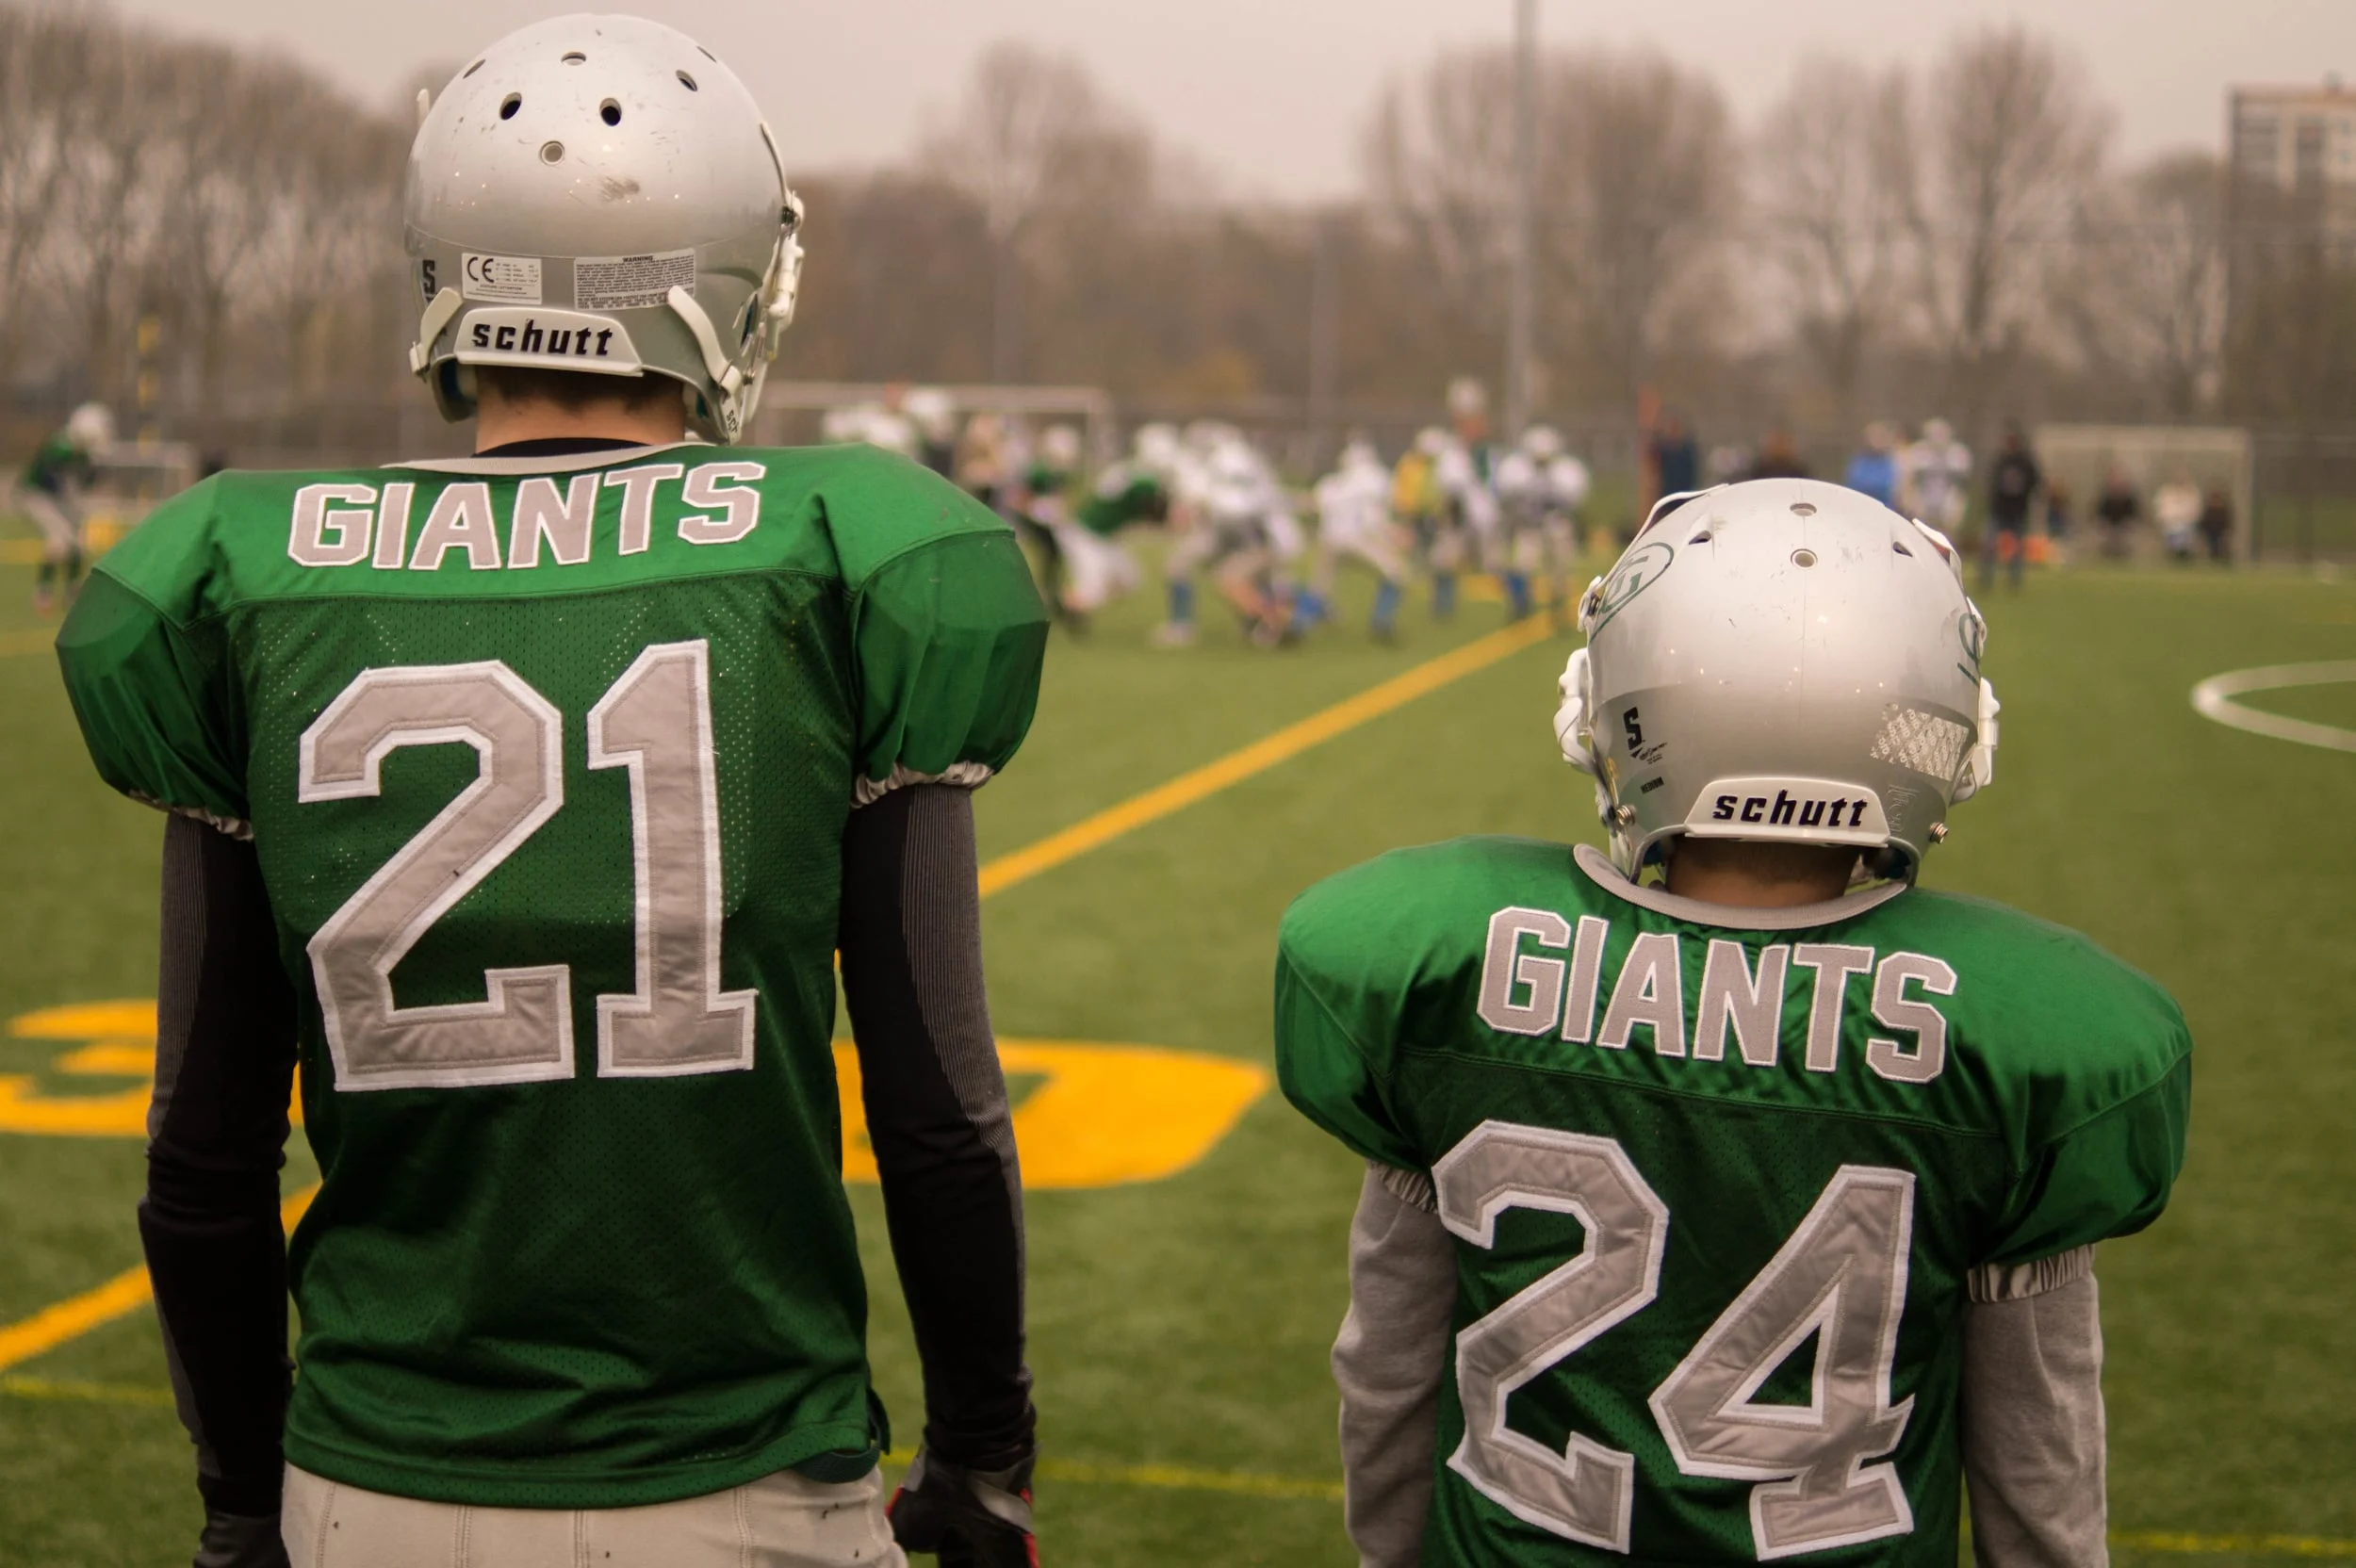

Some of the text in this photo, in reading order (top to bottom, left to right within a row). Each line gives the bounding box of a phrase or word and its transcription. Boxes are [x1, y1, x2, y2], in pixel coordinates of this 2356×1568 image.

[466, 256, 495, 283] CE
[472, 318, 613, 356] schutt
[287, 461, 765, 570] GIANTS
[1711, 789, 1868, 827] schutt
[298, 639, 760, 1092] 21
[1476, 906, 1958, 1084] GIANTS
[1431, 1119, 1917, 1562] 24
